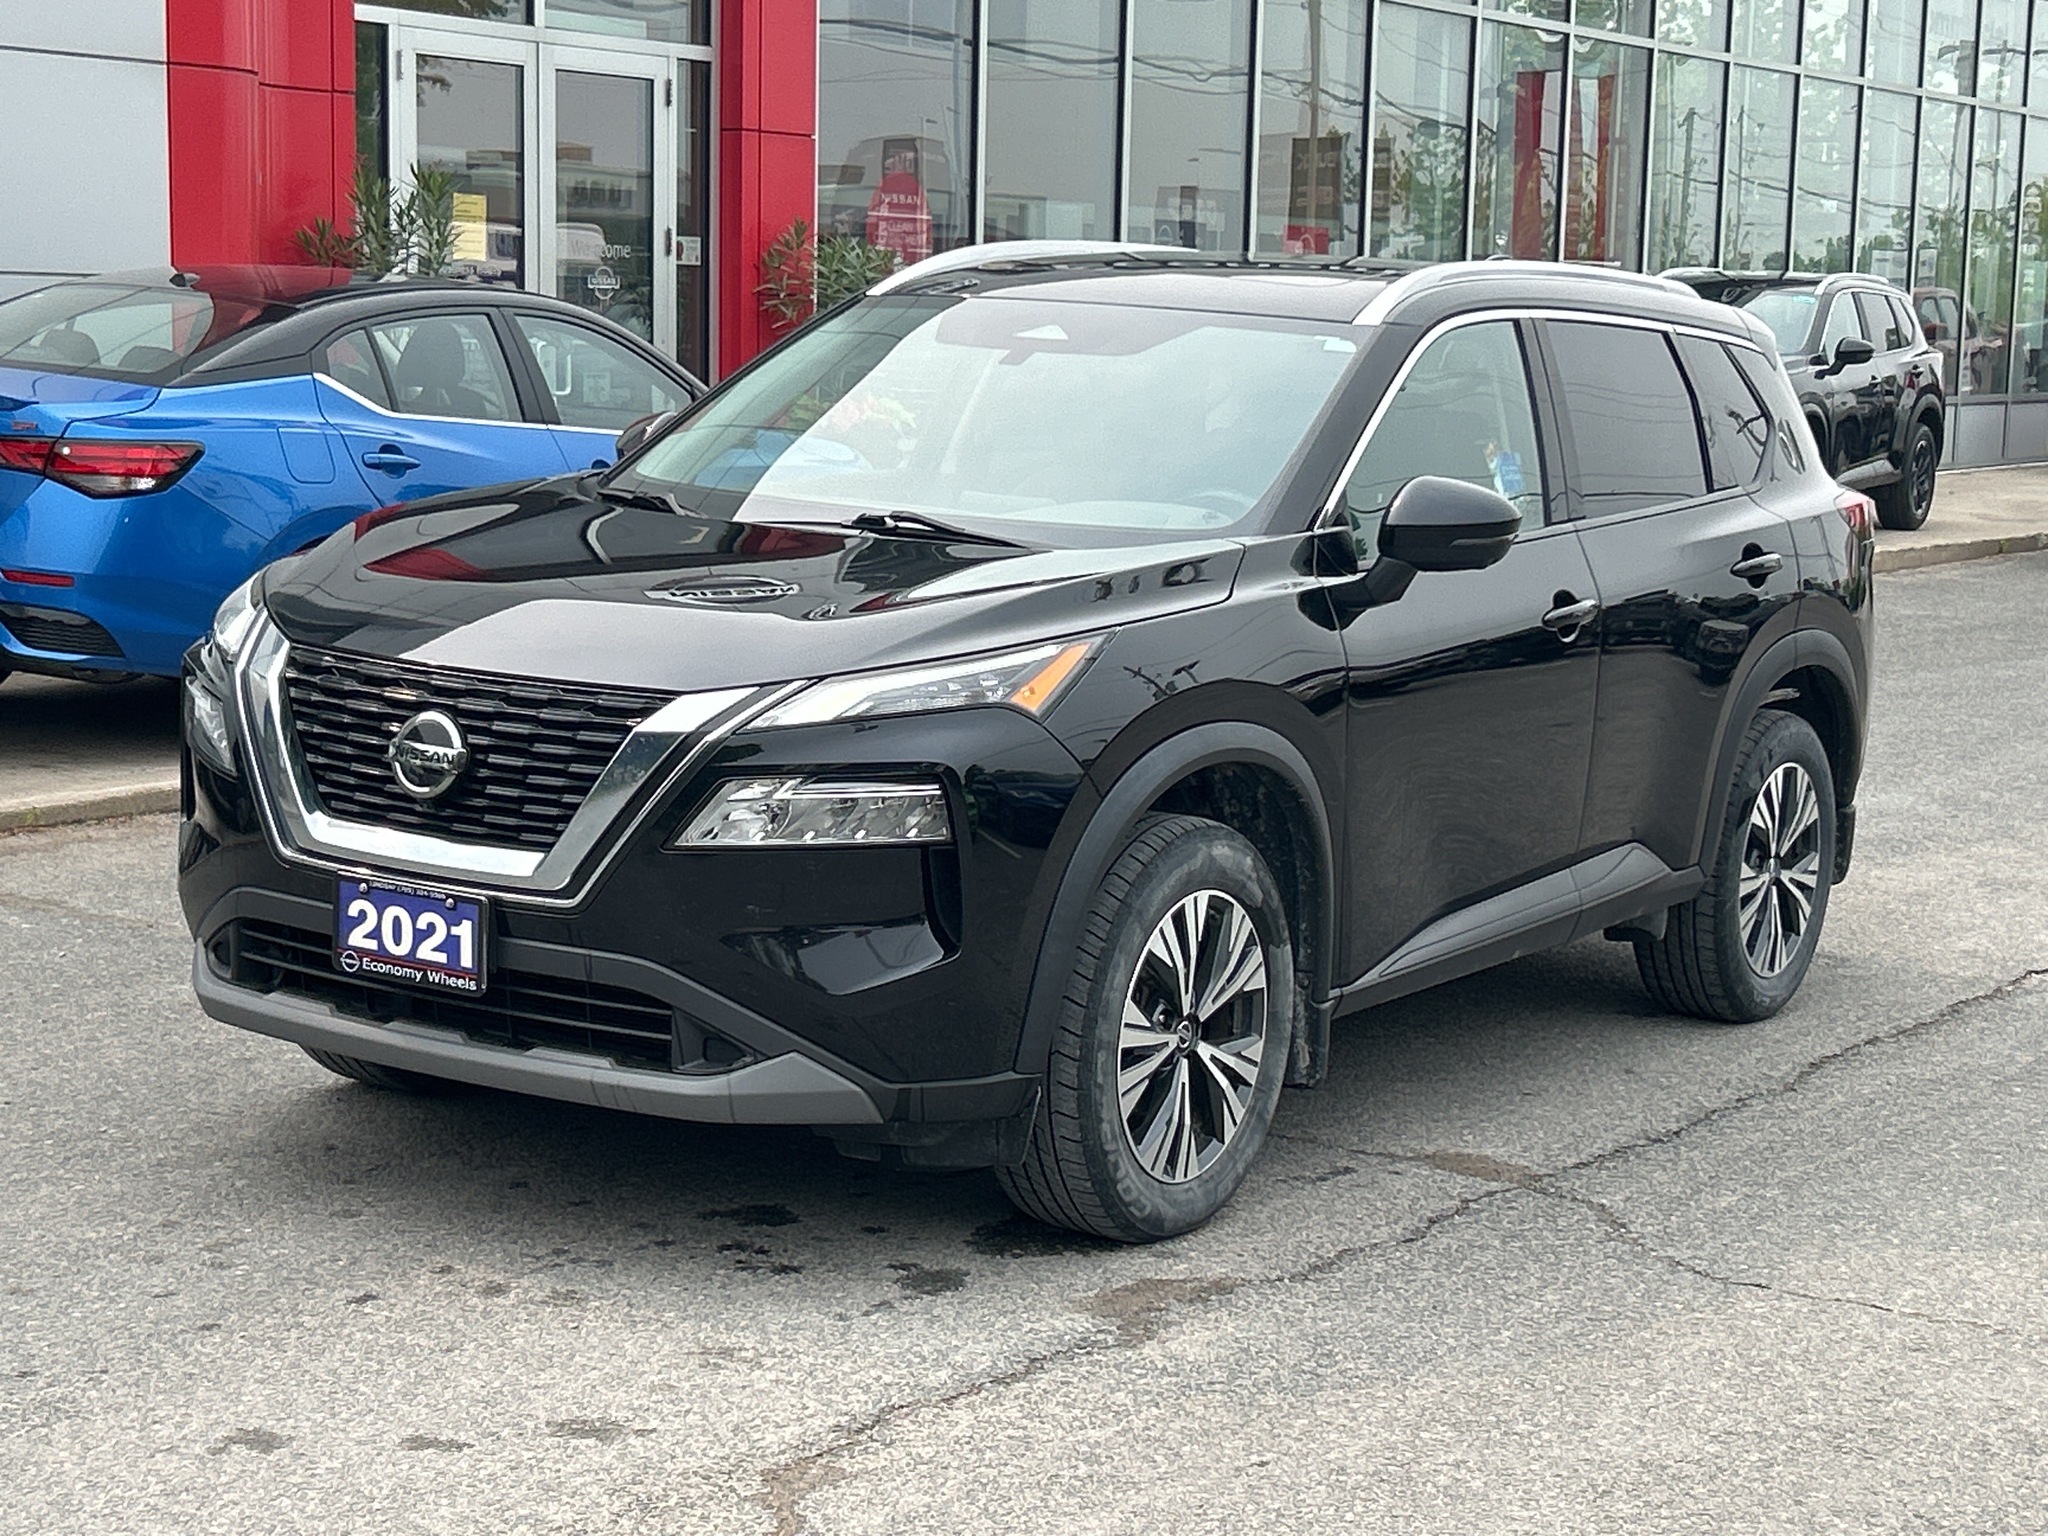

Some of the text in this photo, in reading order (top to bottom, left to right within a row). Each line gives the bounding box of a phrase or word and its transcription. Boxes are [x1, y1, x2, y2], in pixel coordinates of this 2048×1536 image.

[881, 193, 920, 205] NISSAN
[396, 745, 456, 765] NISSAN
[347, 899, 473, 968] 2021
[362, 957, 424, 982] Economy
[427, 969, 478, 991] Wheels
